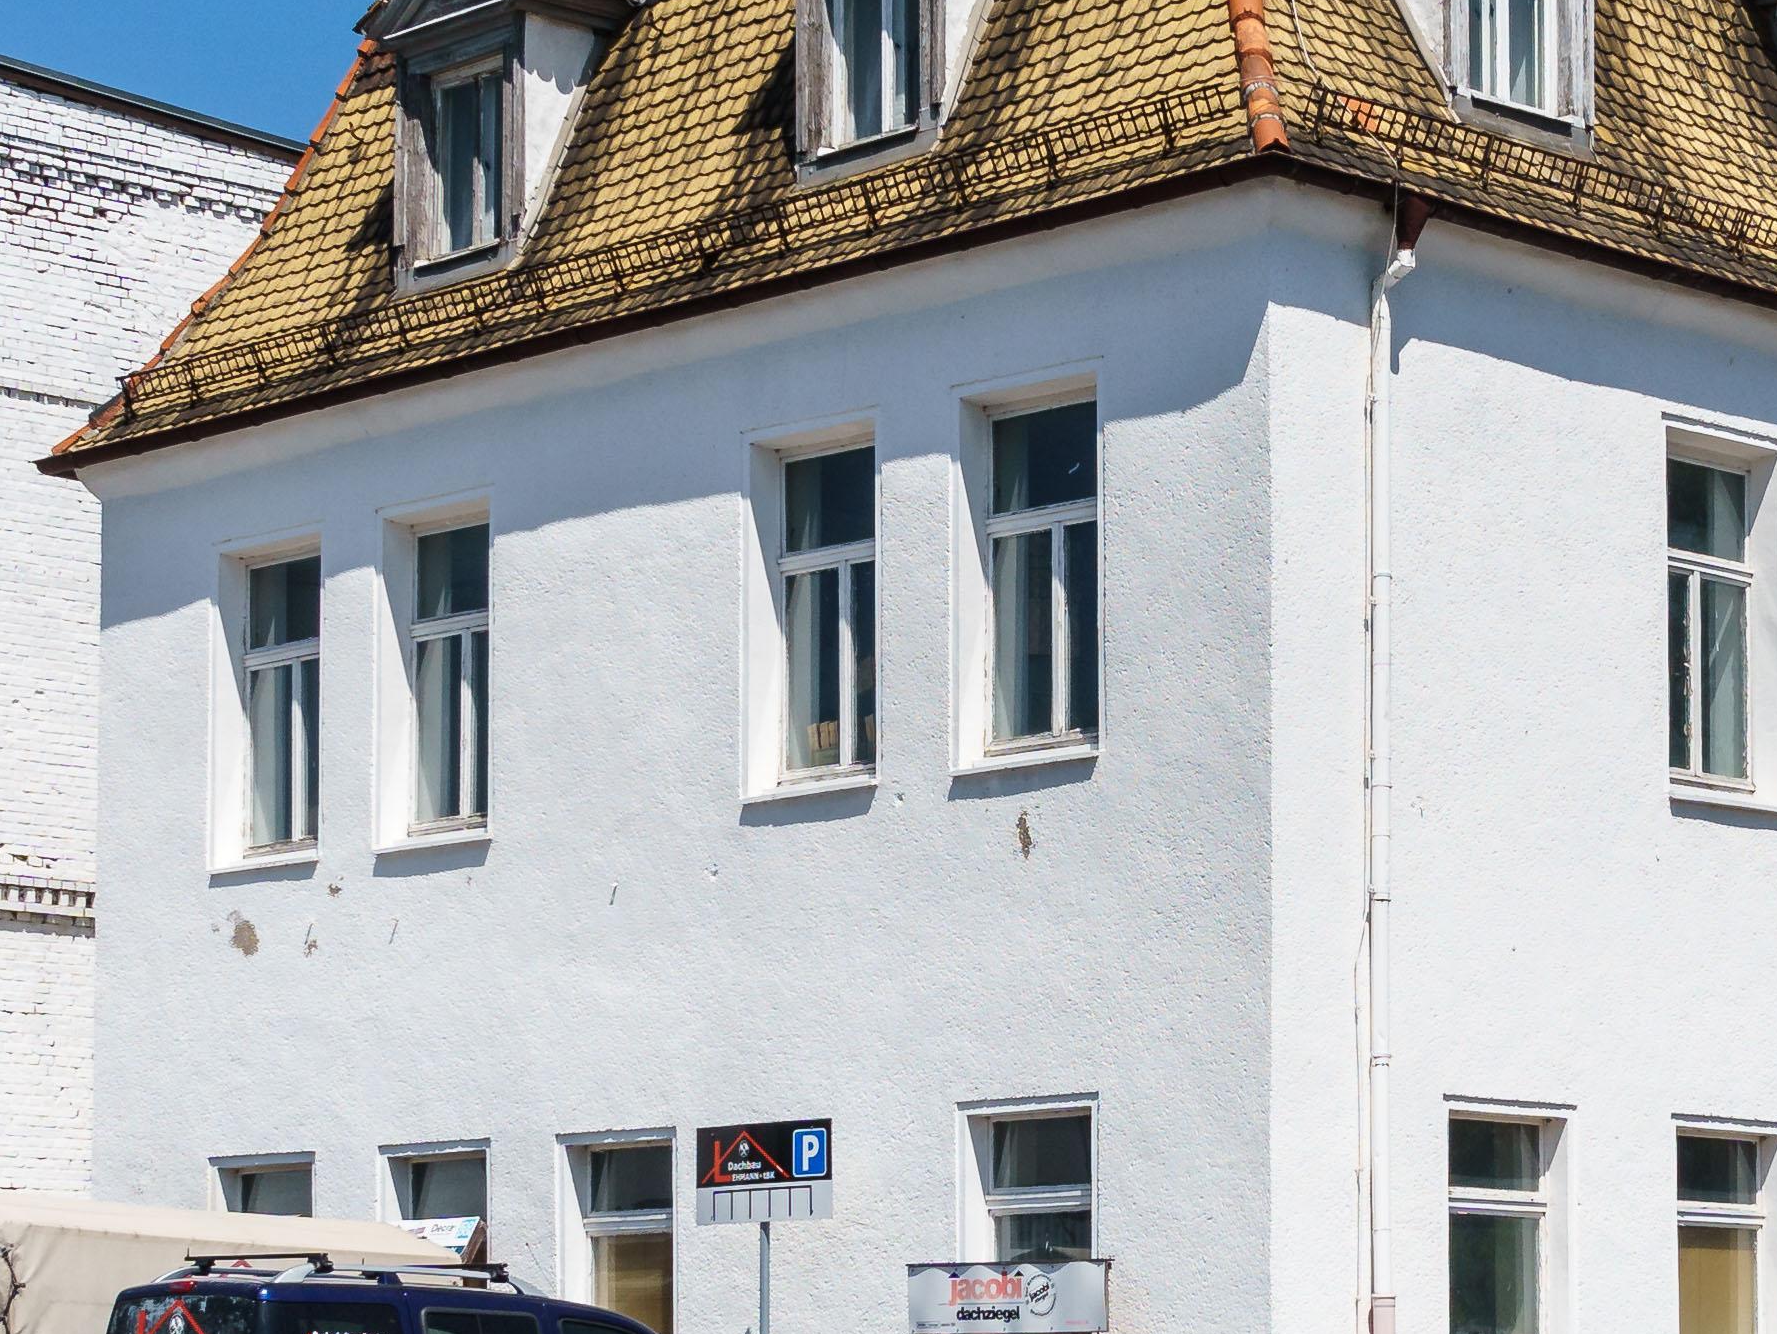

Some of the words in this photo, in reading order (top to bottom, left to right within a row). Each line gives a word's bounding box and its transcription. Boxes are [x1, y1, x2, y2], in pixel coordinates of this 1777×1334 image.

[727, 1160, 762, 1171] Dachbau
[802, 1134, 819, 1172] P
[949, 1274, 1022, 1306] jacobi
[956, 1305, 1020, 1324] dachziegel
